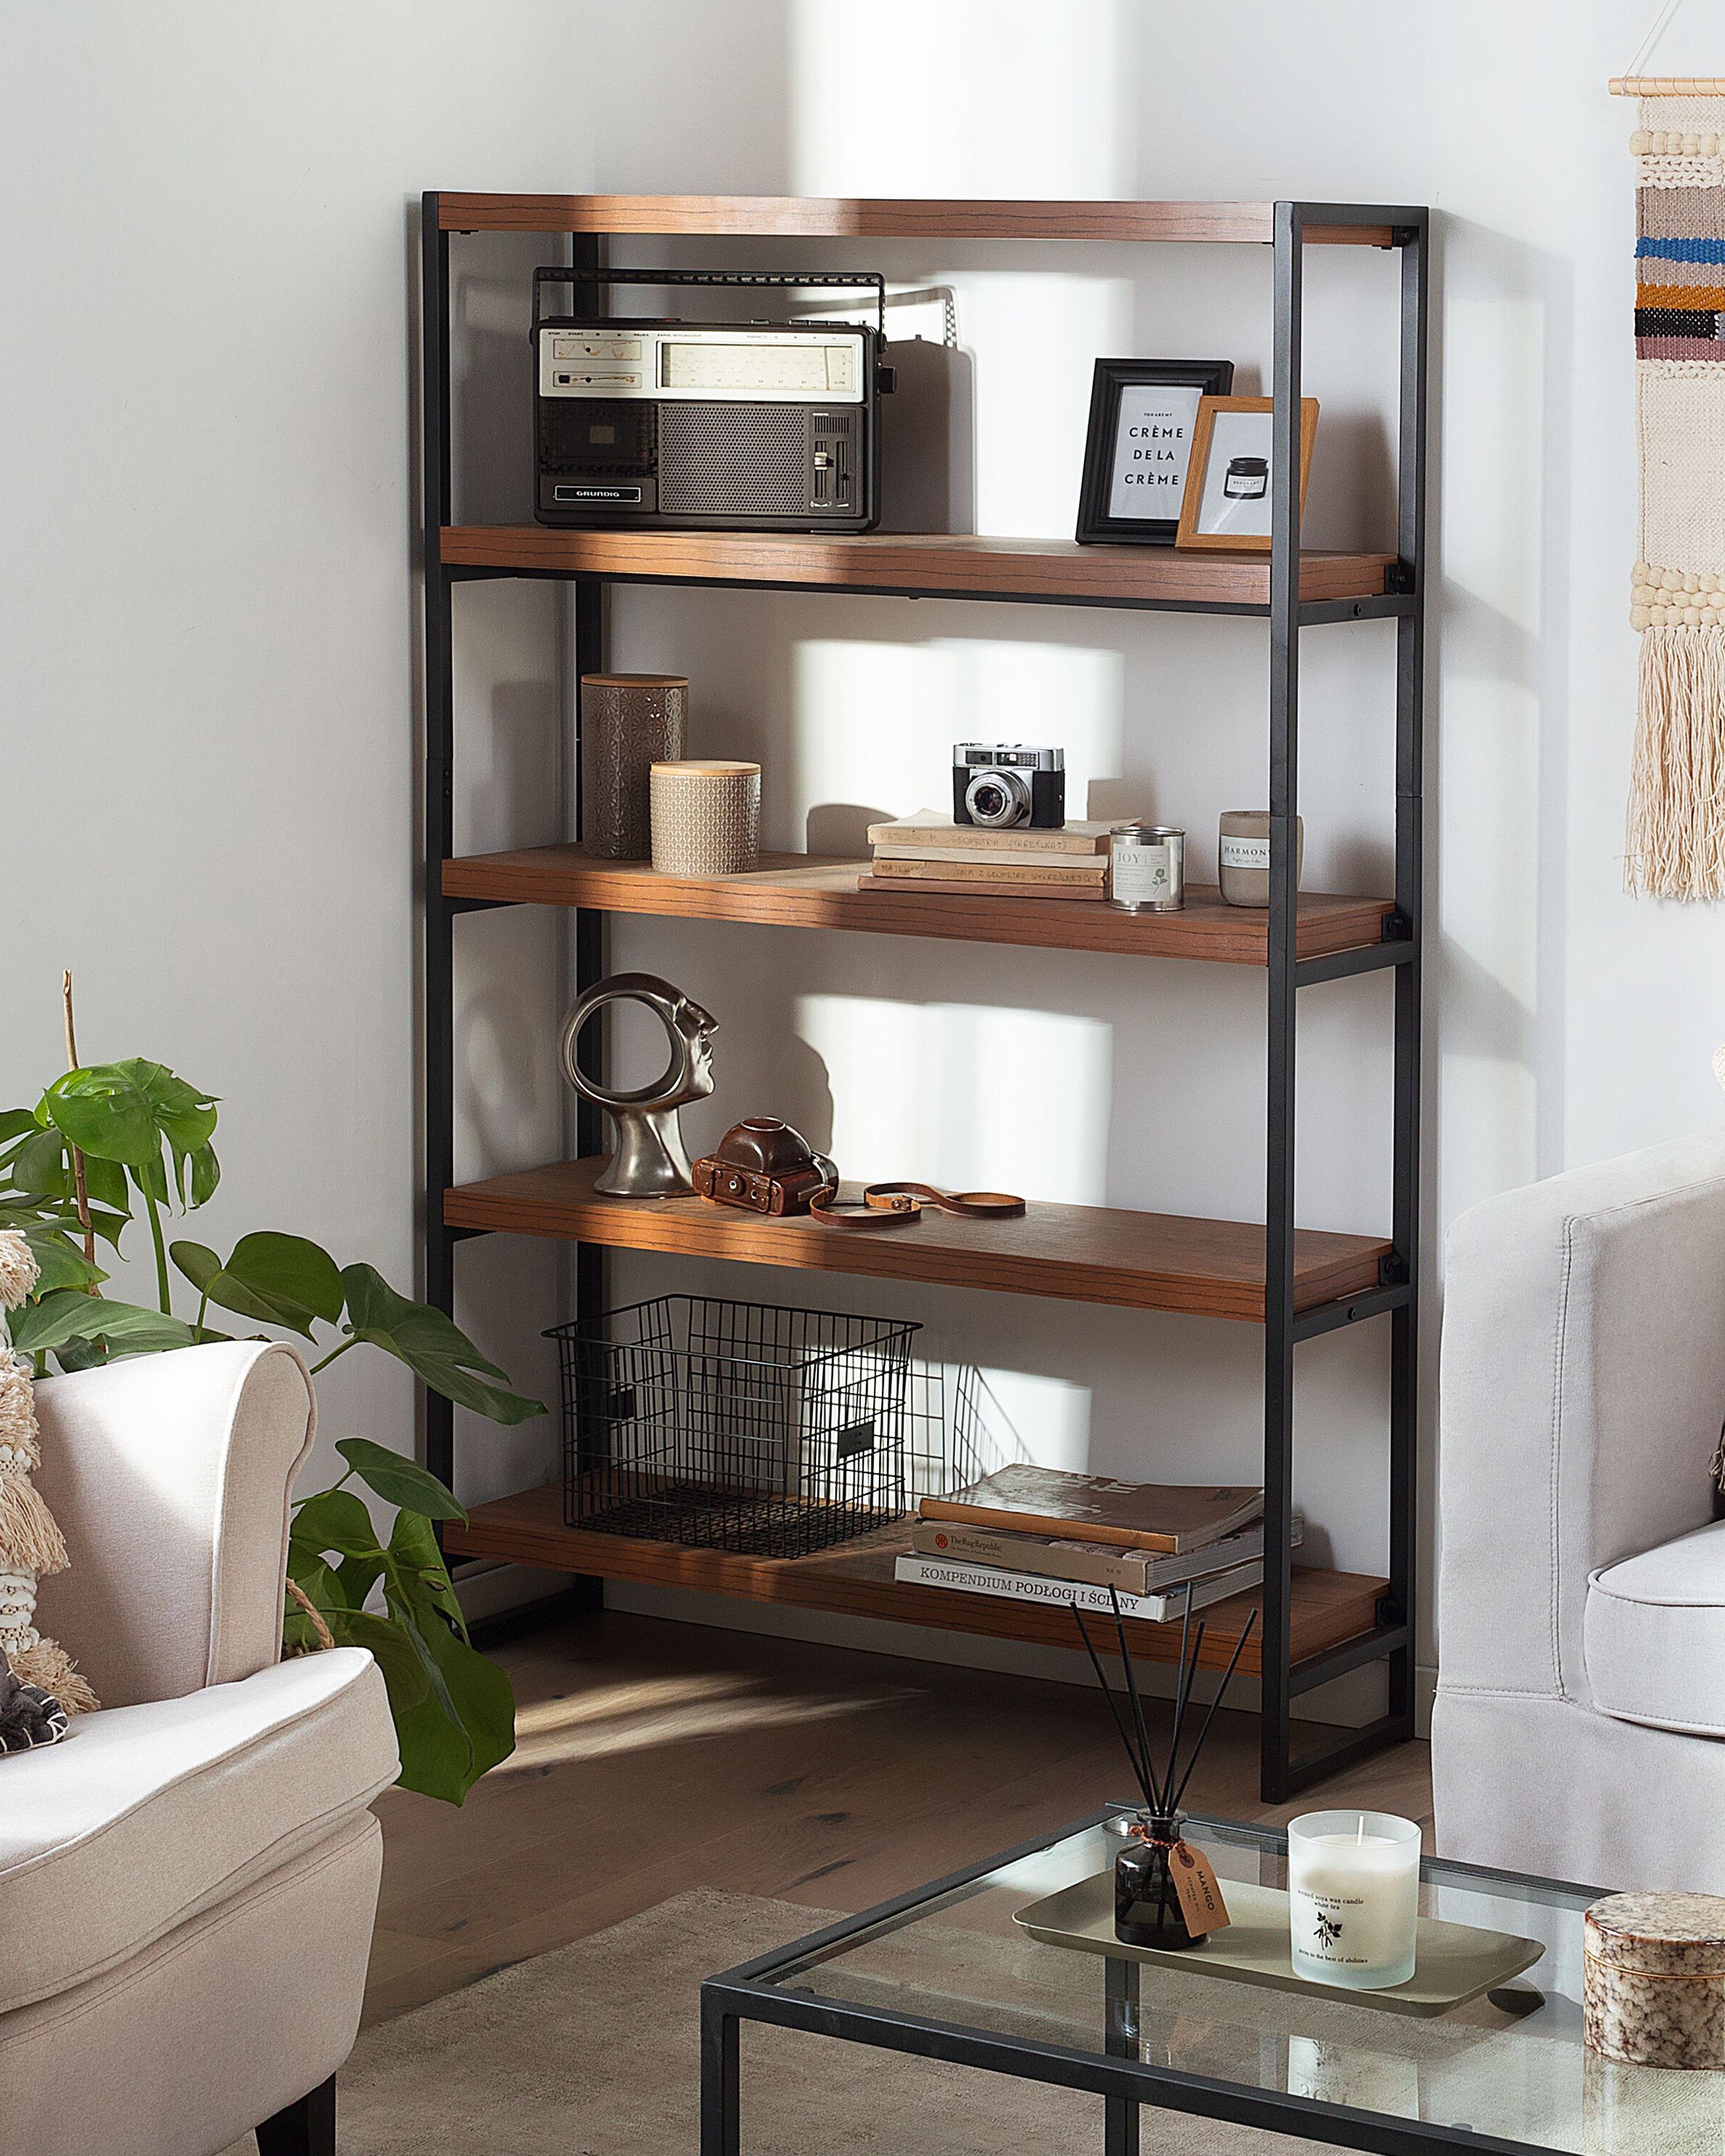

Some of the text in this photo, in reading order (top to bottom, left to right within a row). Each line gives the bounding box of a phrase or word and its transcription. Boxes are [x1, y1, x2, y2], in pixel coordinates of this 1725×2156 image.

[1129, 425, 1183, 438] CRÈME
[1133, 450, 1174, 460] DE LA
[1125, 471, 1179, 484] CRÈME
[1225, 845, 1269, 856] HARMON
[1117, 852, 1140, 863] JOY
[920, 1567, 1138, 1610] KOMPENDIUM PODŁOGI I ŚCINY
[1196, 1871, 1215, 1910] MANGO
